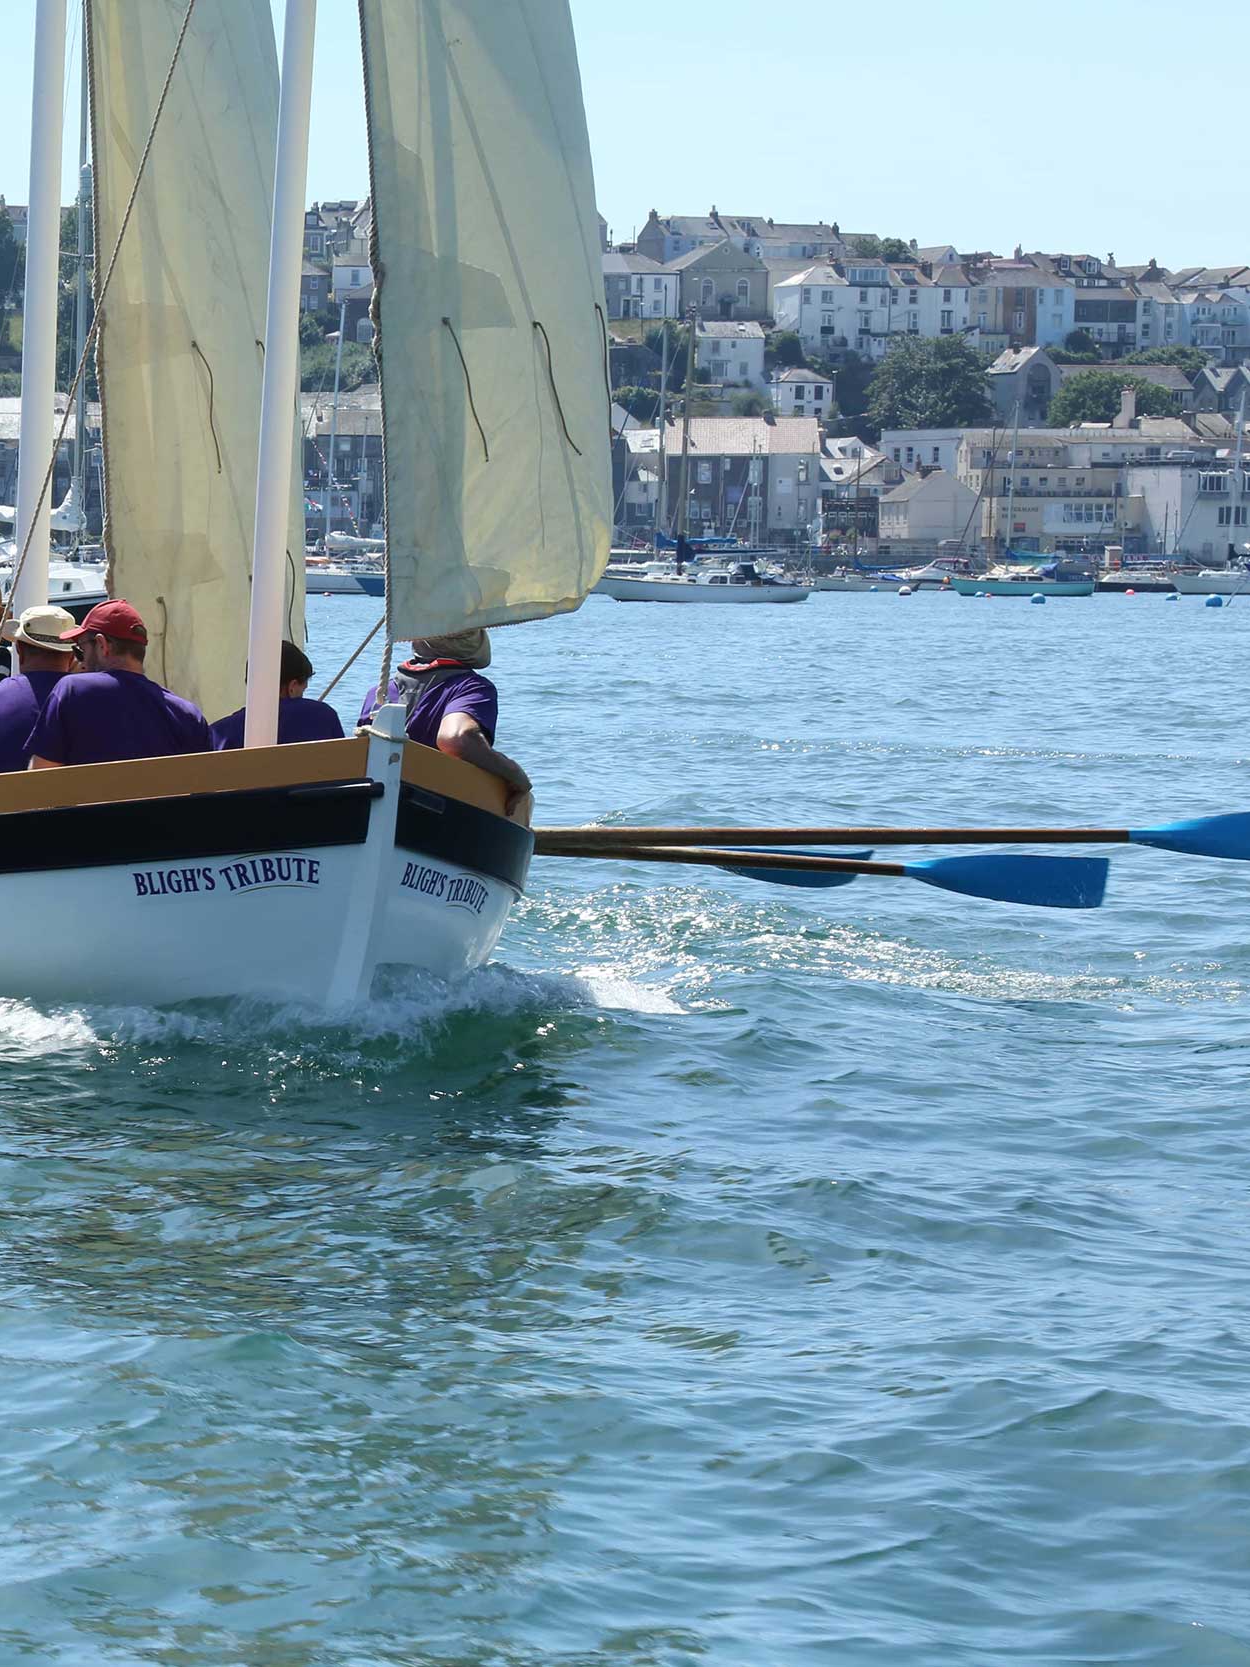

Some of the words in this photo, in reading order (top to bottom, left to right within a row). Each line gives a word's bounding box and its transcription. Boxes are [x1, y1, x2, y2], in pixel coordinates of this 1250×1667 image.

[133, 867, 216, 896] BLIGH'S
[219, 857, 321, 892] TRIBUTE
[400, 862, 448, 897] BLIGH'S
[446, 878, 489, 914] TRIBUTE
